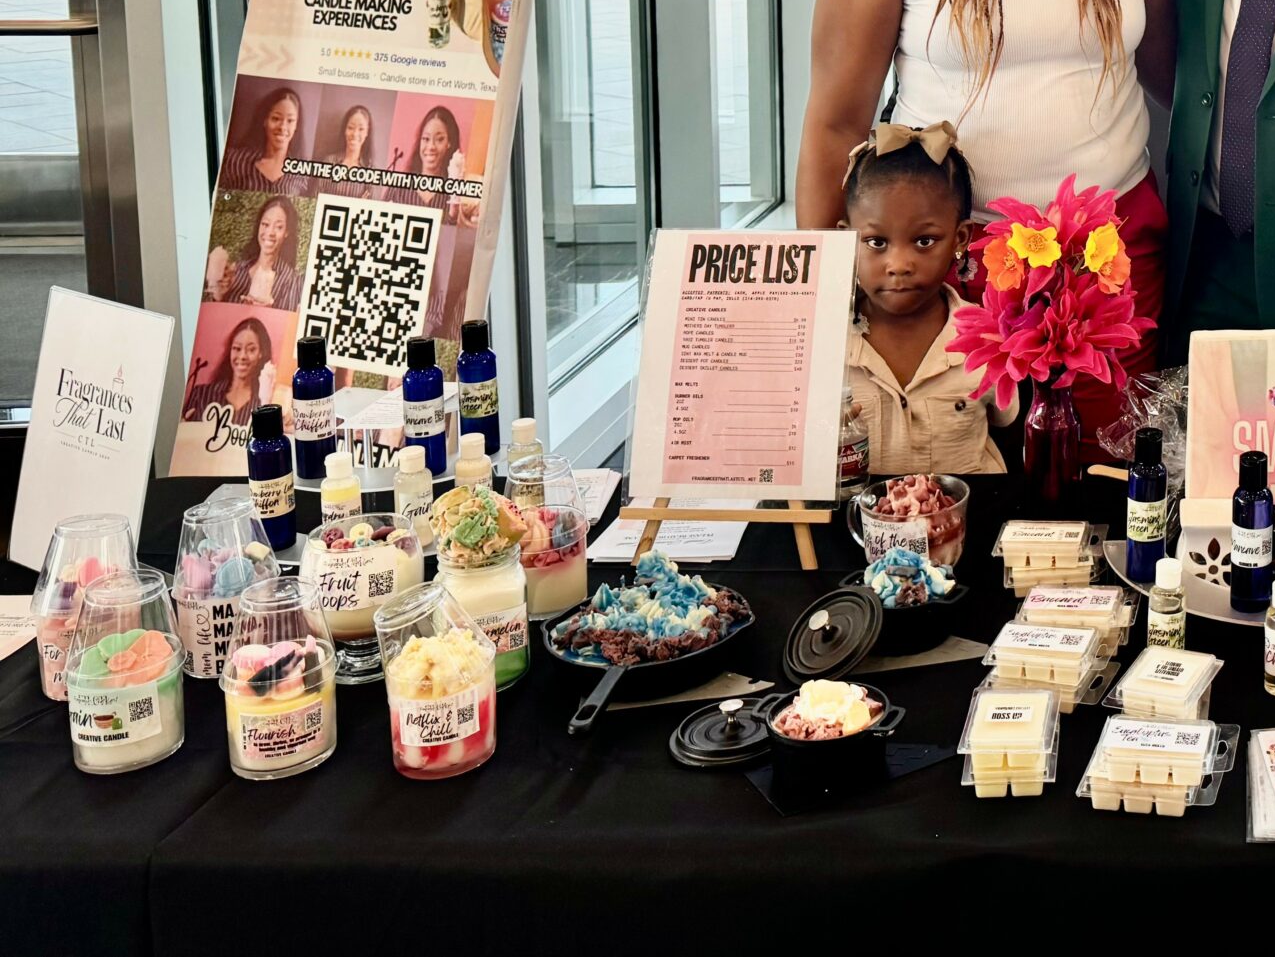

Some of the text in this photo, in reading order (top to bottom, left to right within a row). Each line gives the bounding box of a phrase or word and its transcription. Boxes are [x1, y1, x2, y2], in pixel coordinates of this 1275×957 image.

[313, 10, 398, 31] EXPERIENCES
[320, 48, 447, 68] 5.0 375 Google reviews
[318, 67, 336, 78] Small
[337, 69, 370, 81] business
[380, 72, 407, 84] Candle
[408, 75, 428, 86] store
[428, 76, 436, 87] in
[437, 77, 452, 89] Fort
[480, 81, 497, 93] Texa
[283, 159, 483, 198] SCAN THE QR CODE WITH YOUR CAMER
[689, 244, 816, 284] PRICE LIST
[57, 367, 133, 414] Fragrances
[53, 397, 125, 442] That Last
[295, 418, 331, 433] Chiffon
[77, 435, 95, 447] CTL
[402, 503, 432, 520] Gain
[874, 532, 886, 547] of
[890, 533, 908, 547] the
[320, 571, 361, 592] Fruit
[1030, 594, 1088, 604] Baccarat
[406, 710, 453, 726] Netflix &
[991, 712, 1011, 720] BOSS
[78, 731, 130, 743] CREATIVE CANDLE
[247, 724, 296, 741] Flourish
[420, 724, 453, 739] Chill
[1121, 734, 1139, 743] Tea
